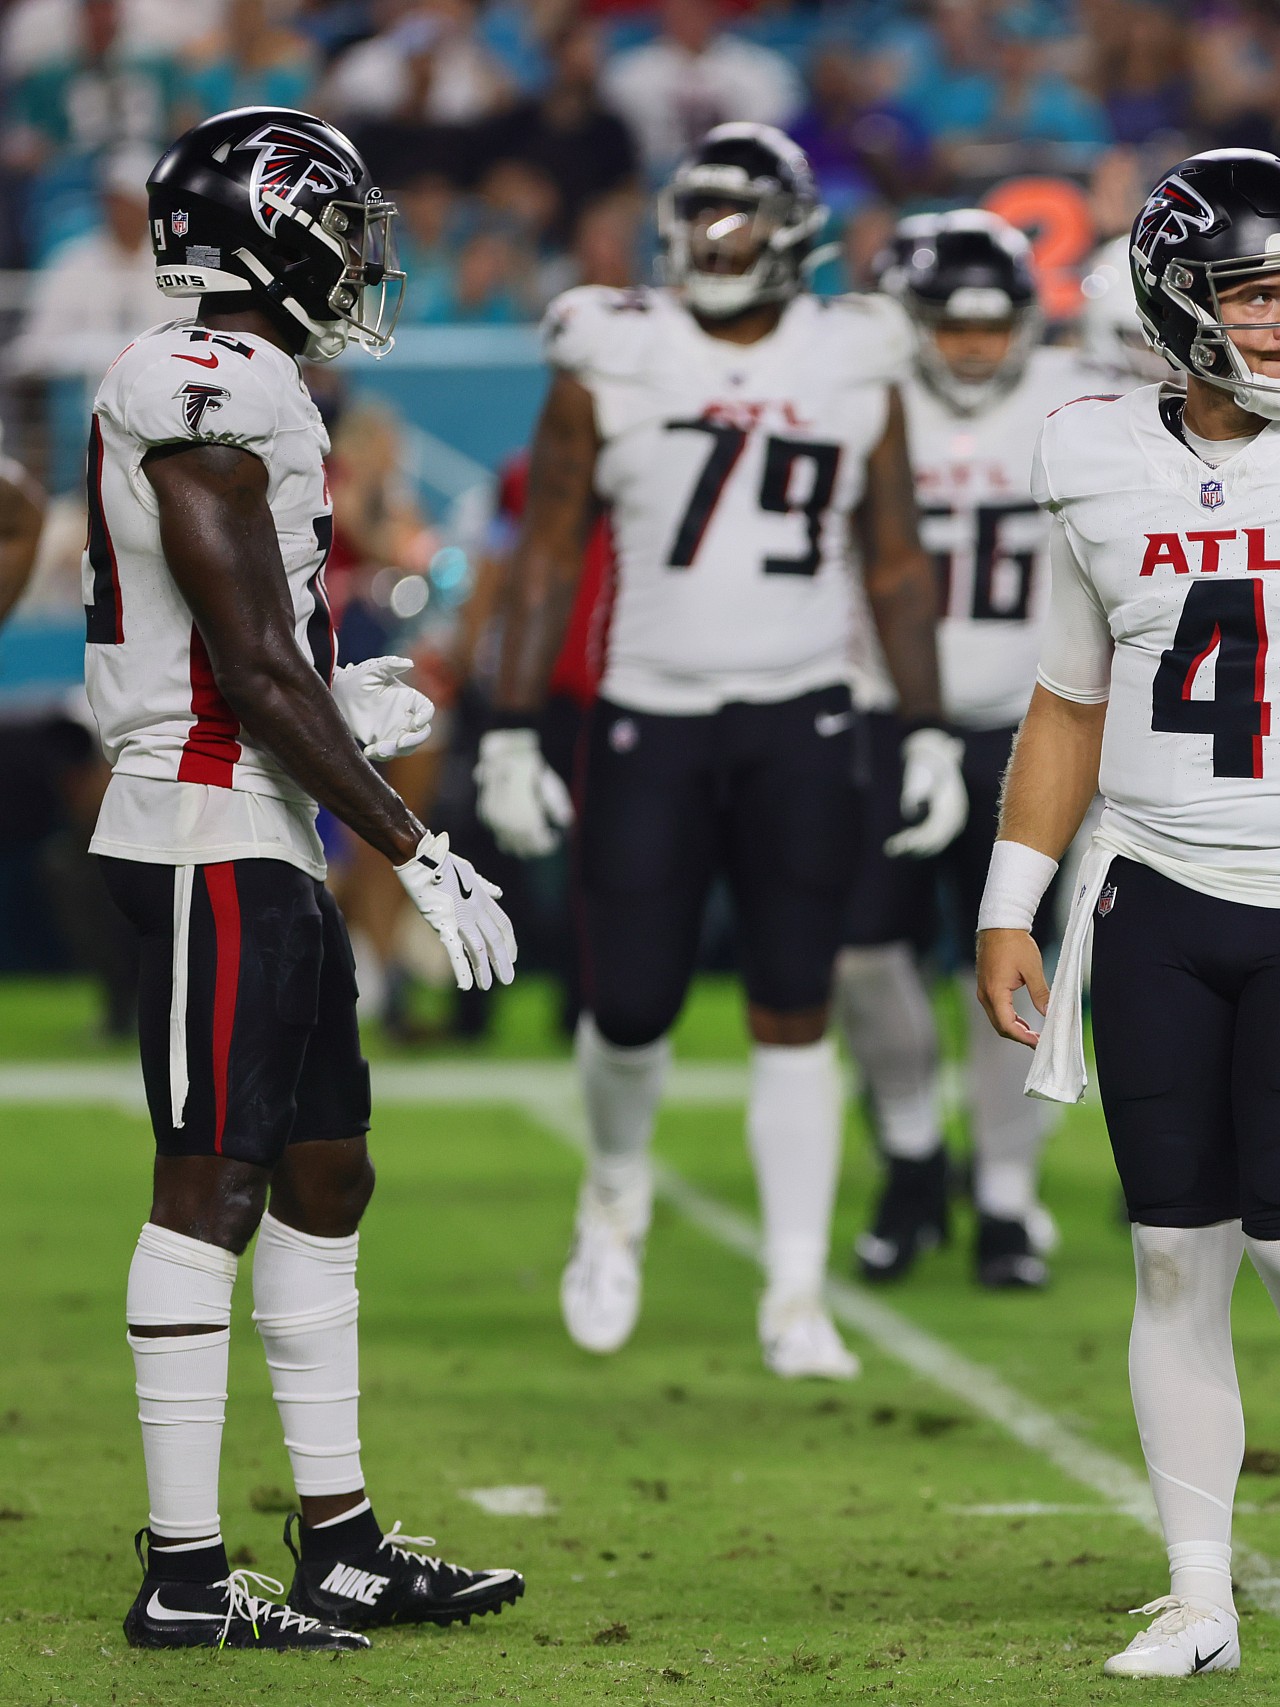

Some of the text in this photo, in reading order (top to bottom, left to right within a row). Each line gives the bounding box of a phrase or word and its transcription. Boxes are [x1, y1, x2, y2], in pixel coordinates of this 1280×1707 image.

[664, 416, 841, 577] 79
[1203, 491, 1221, 505] NFL
[1151, 578, 1272, 779] 4
[320, 1561, 391, 1606] NIKE
